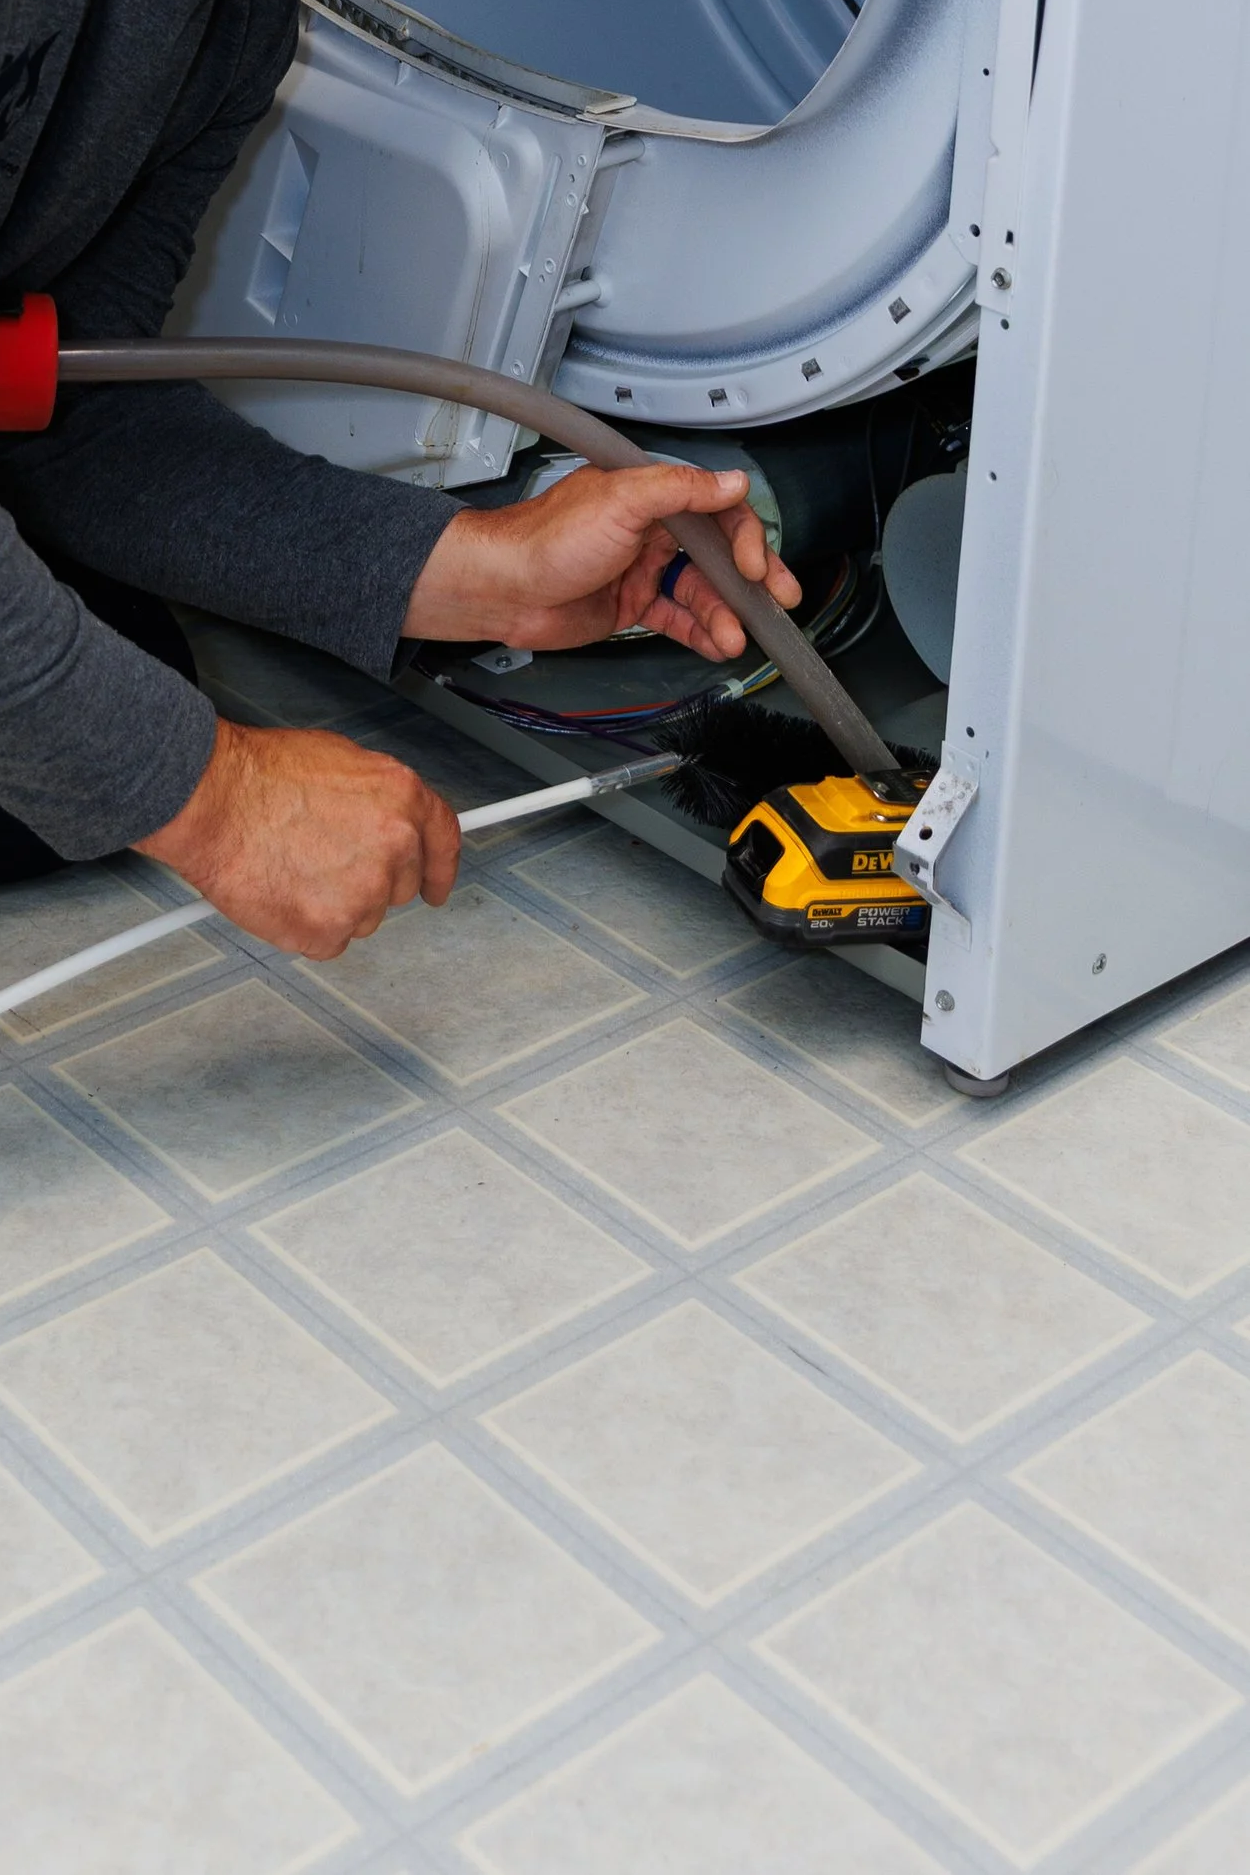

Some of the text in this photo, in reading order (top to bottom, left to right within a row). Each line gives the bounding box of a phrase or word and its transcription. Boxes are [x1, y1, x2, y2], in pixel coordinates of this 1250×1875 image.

[852, 852, 895, 871] DEW
[858, 906, 911, 917] POWER
[857, 916, 904, 927] STACK
